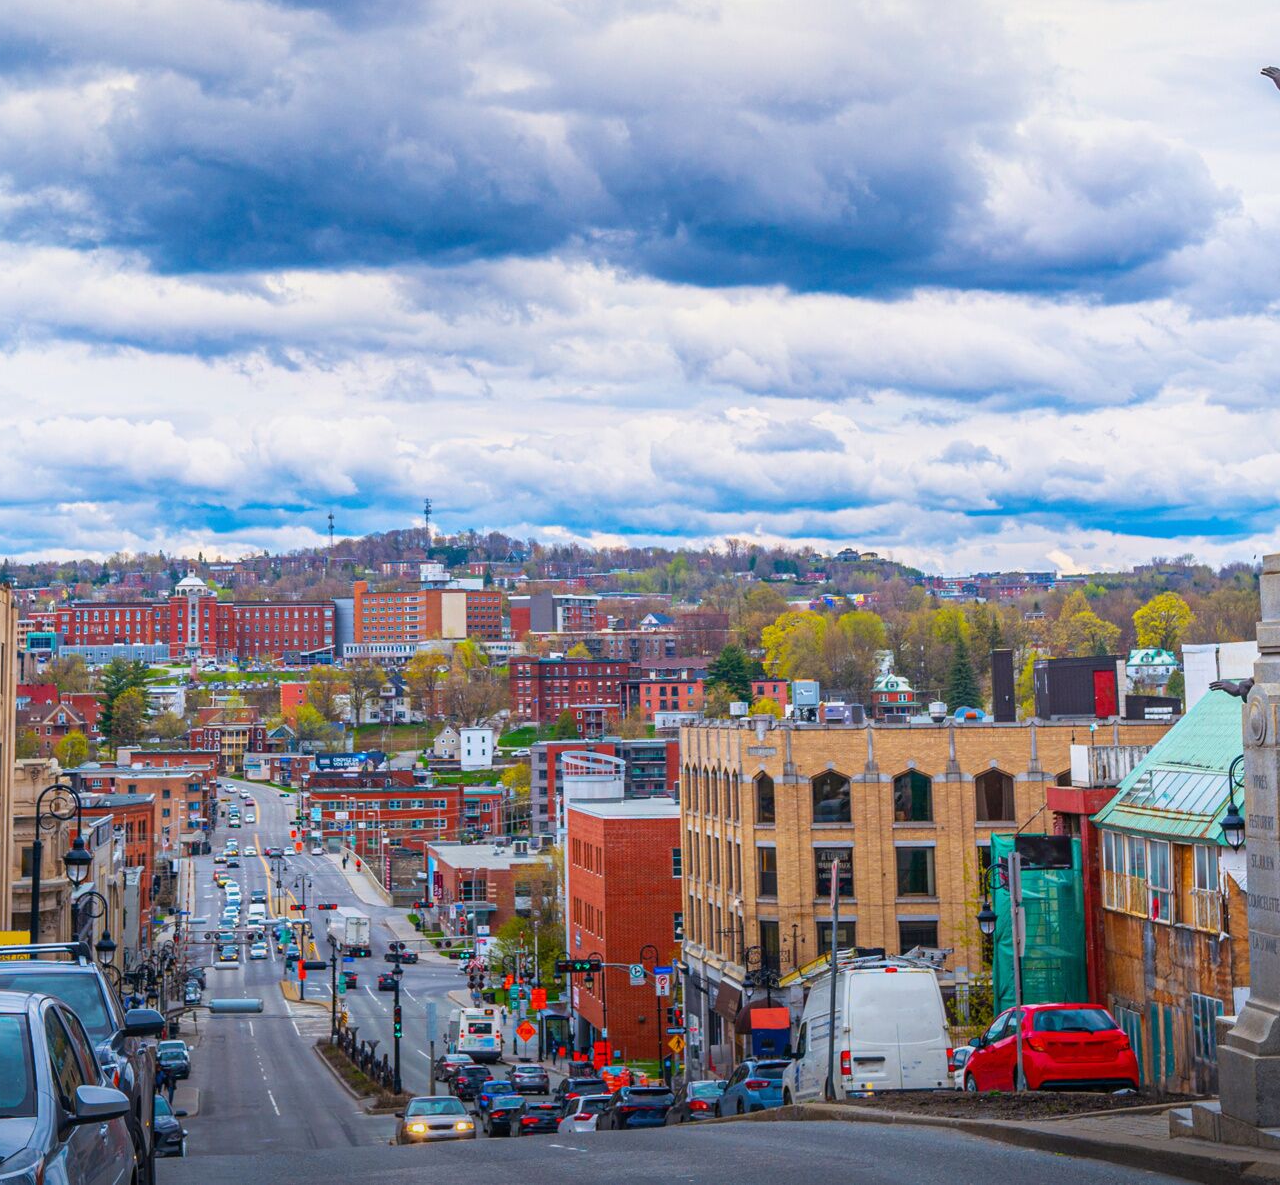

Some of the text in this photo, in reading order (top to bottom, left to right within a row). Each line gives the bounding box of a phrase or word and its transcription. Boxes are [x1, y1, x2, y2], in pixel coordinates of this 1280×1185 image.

[1252, 774, 1268, 790] YPRES
[1248, 814, 1274, 831] FESTUBERT
[1248, 893, 1280, 913] COURCELETTE
